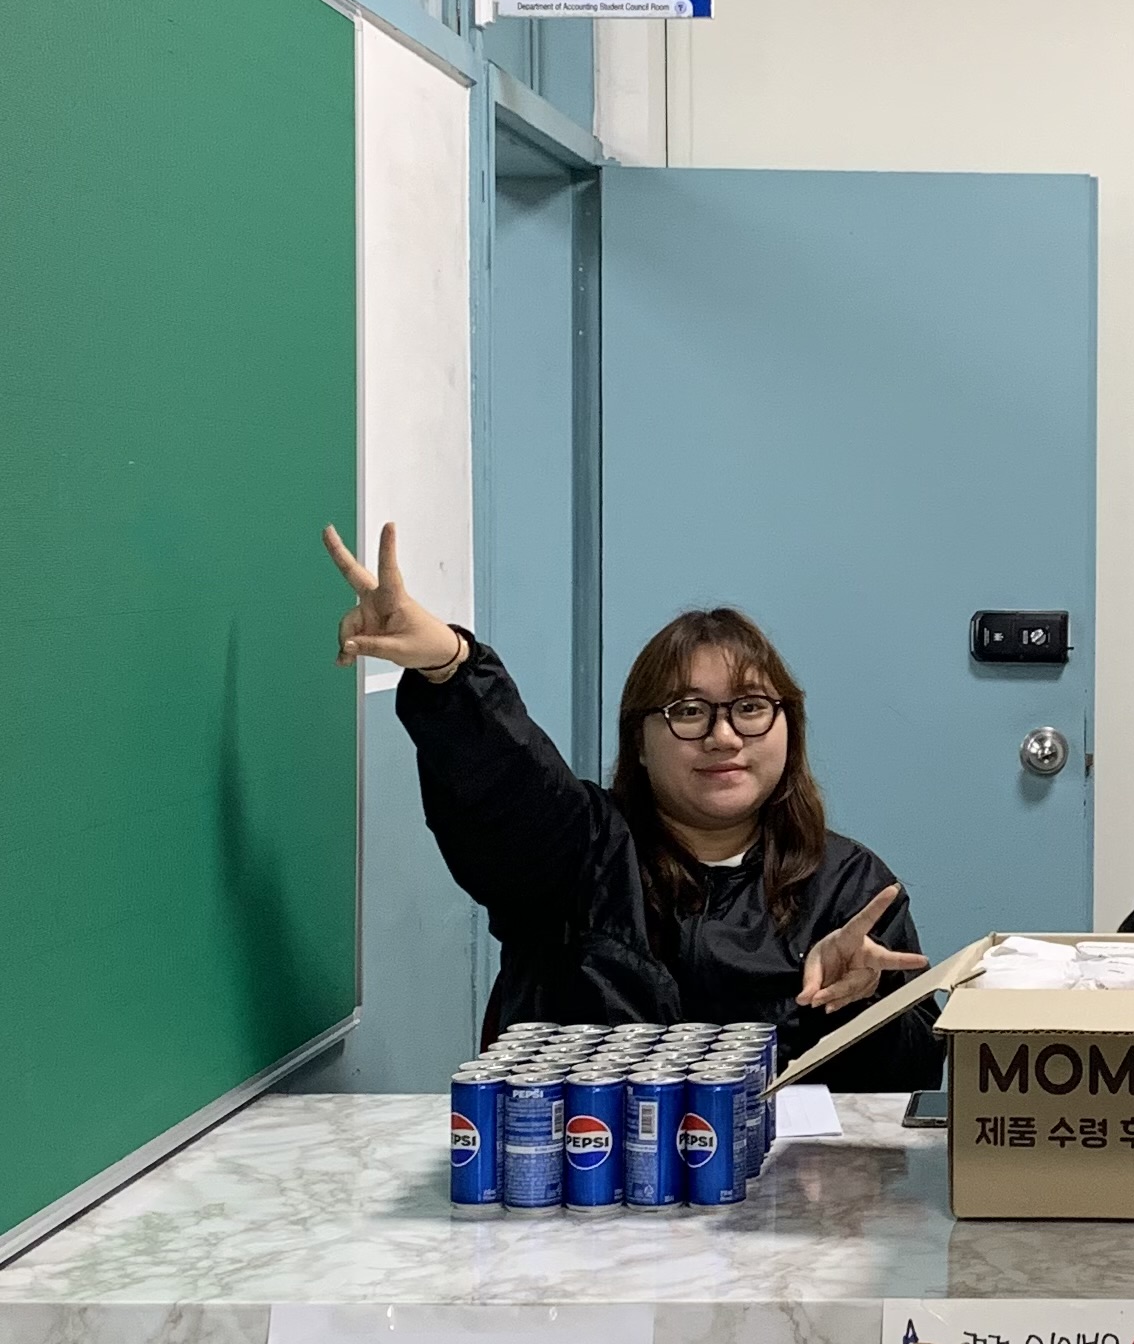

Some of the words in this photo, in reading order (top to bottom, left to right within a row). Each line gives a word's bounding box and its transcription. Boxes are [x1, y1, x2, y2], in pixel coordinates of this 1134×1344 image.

[517, 2, 553, 12] Department
[563, 2, 598, 13] Accounting
[600, 2, 624, 12] Student
[626, 2, 649, 12] Council
[651, 2, 670, 12] Room
[513, 1089, 543, 1098] PEPSI
[975, 1115, 1038, 1148] 제품
[1048, 1116, 1108, 1150] 수령
[566, 1135, 610, 1149] PEPSI
